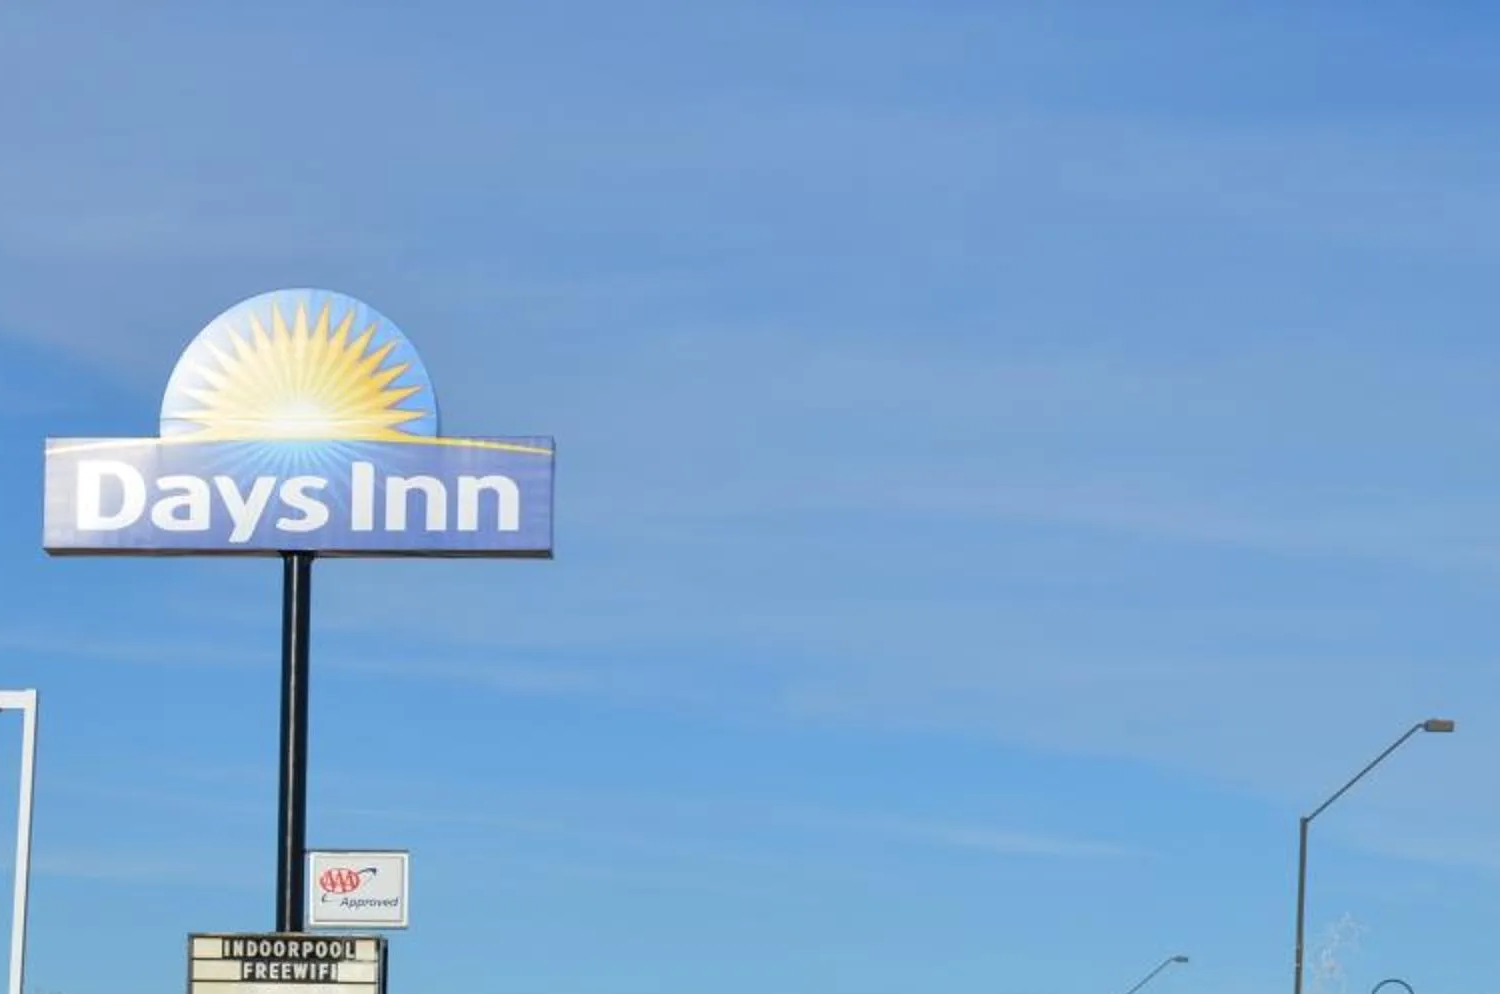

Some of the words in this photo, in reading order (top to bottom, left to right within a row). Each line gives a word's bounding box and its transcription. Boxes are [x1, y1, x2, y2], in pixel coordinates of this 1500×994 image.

[76, 460, 328, 543] Days
[351, 461, 520, 532] Inn
[322, 868, 359, 893] AAA
[340, 897, 399, 909] Approved
